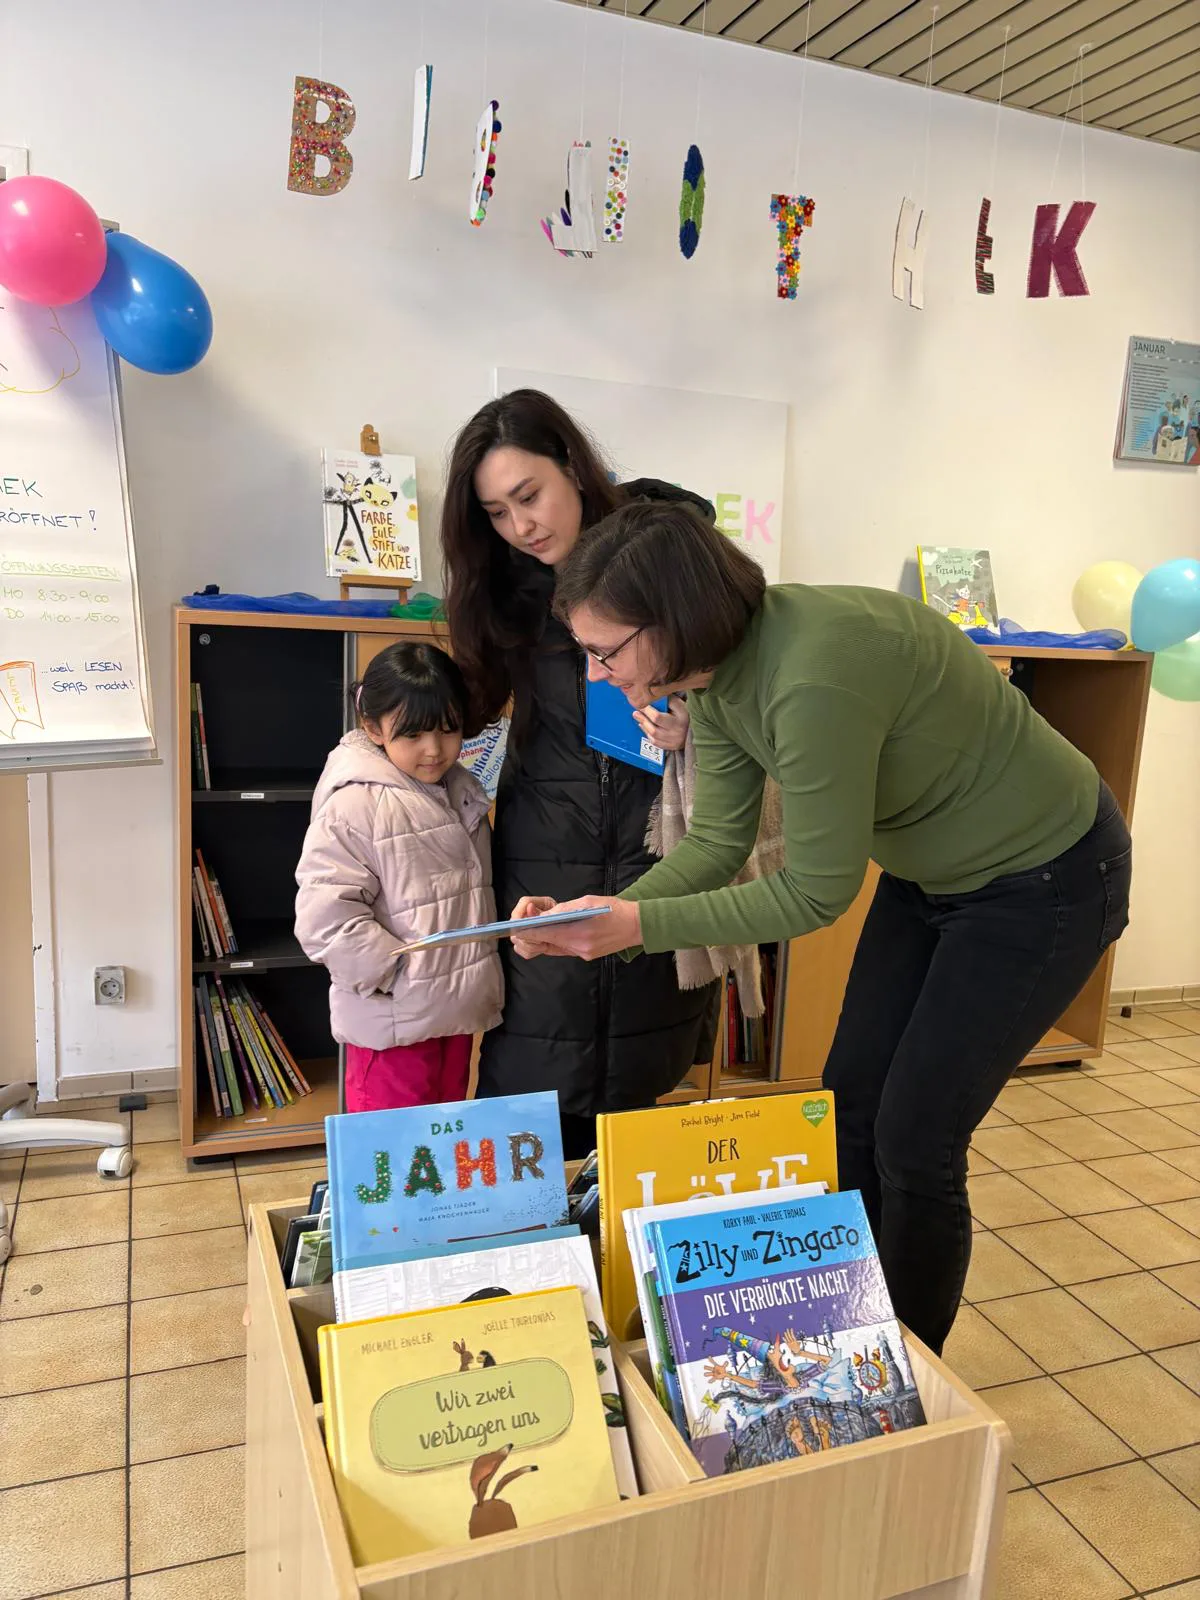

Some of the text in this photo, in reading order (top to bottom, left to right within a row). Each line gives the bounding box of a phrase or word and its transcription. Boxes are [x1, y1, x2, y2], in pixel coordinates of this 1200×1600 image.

[1133, 341, 1165, 354] JANUAR
[0, 478, 43, 498] EK
[372, 539, 395, 552] STIFT
[378, 552, 411, 570] KATZE
[4, 607, 24, 620] DO
[84, 661, 122, 672] LESEN
[431, 1119, 464, 1136] DAS
[708, 1138, 740, 1164] DER
[354, 1131, 545, 1204] JAHR
[723, 1206, 807, 1229] KORKY PAUL VALERIE THOMAS
[666, 1224, 860, 1284] Zilly UND Zingaro
[704, 1268, 851, 1319] DIE VERRÜCKTE NACHT
[361, 1338, 398, 1355] MICHAEL
[435, 1381, 516, 1413] Wir zwei
[419, 1411, 540, 1449] vertragen uns
